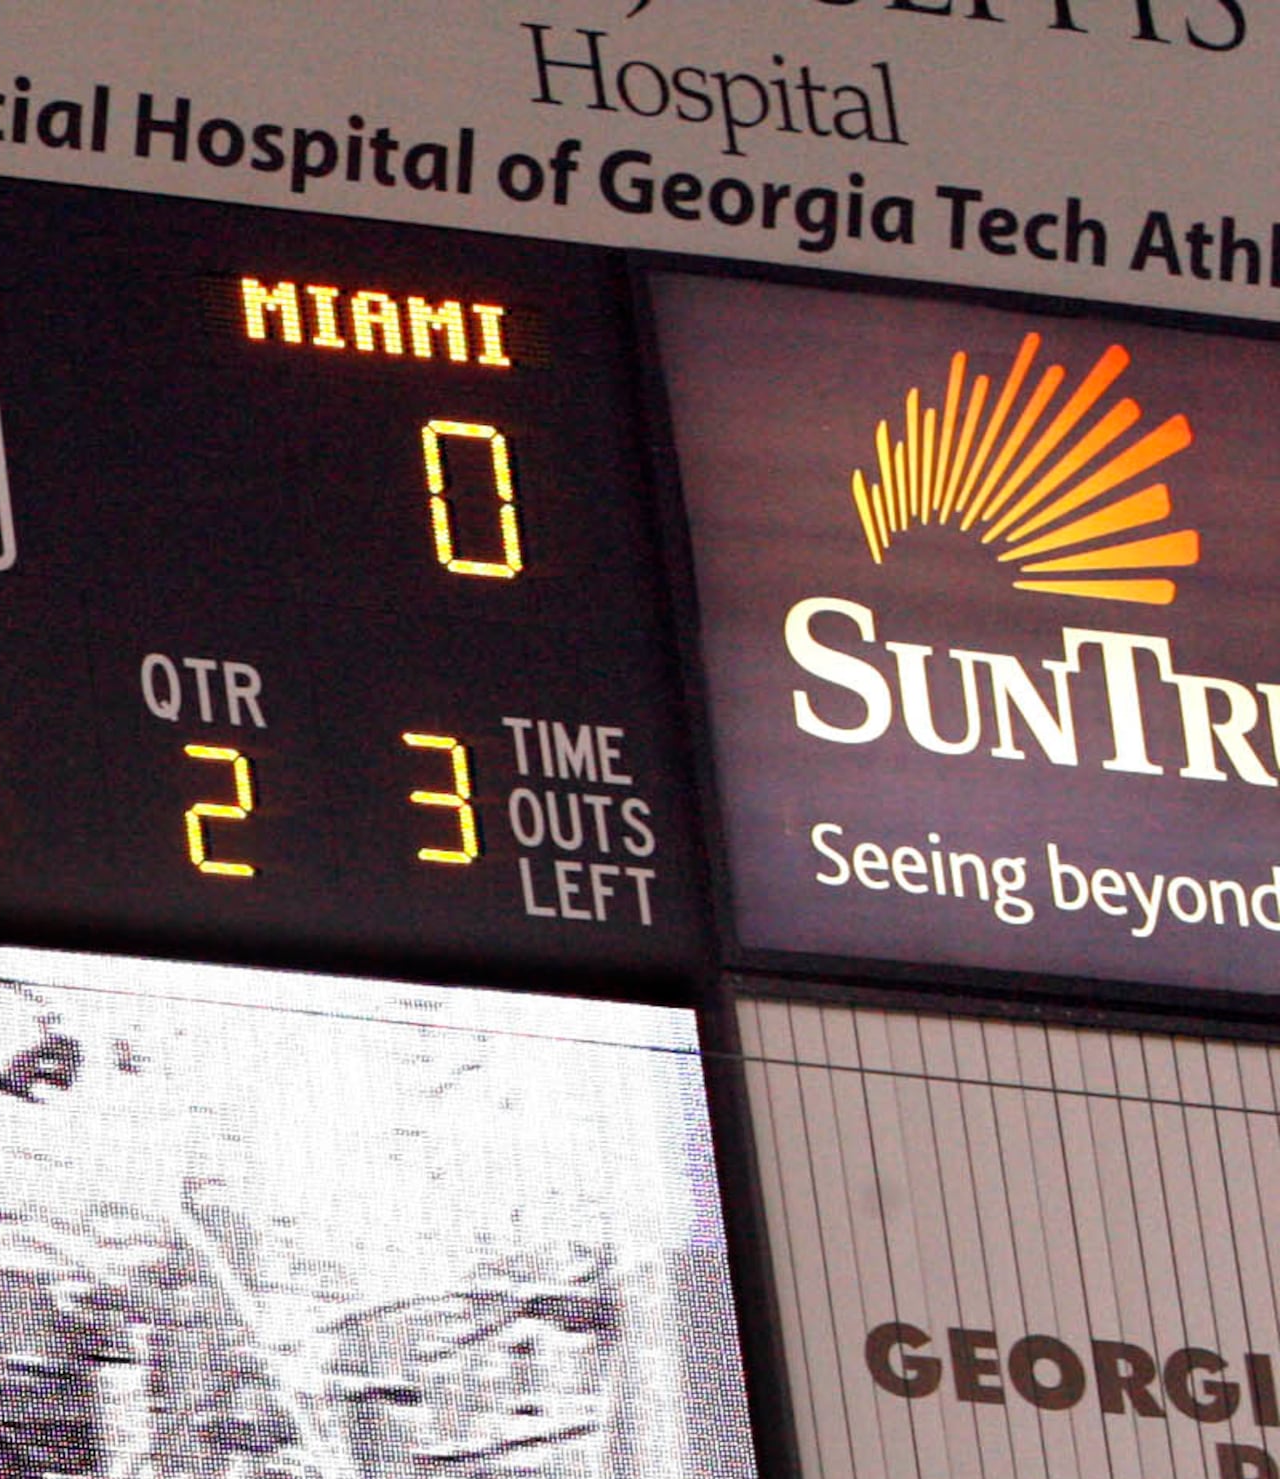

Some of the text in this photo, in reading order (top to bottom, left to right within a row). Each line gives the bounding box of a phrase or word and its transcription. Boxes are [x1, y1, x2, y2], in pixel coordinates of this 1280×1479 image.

[520, 22, 909, 156] Hospital
[133, 92, 473, 194] Hospital
[497, 139, 581, 206] of
[599, 149, 915, 254] Georgia
[935, 185, 1107, 268] Tech
[240, 278, 512, 368] MIAMI
[422, 420, 522, 580] 0
[141, 653, 268, 728] QTR
[401, 732, 479, 864] 3
[501, 716, 633, 786] TIME
[183, 743, 257, 878] 2
[509, 790, 656, 858] OUTS
[517, 857, 656, 926] LEFT
[811, 822, 1280, 938] Seeing beyond
[864, 1322, 1280, 1427] GEORGI
